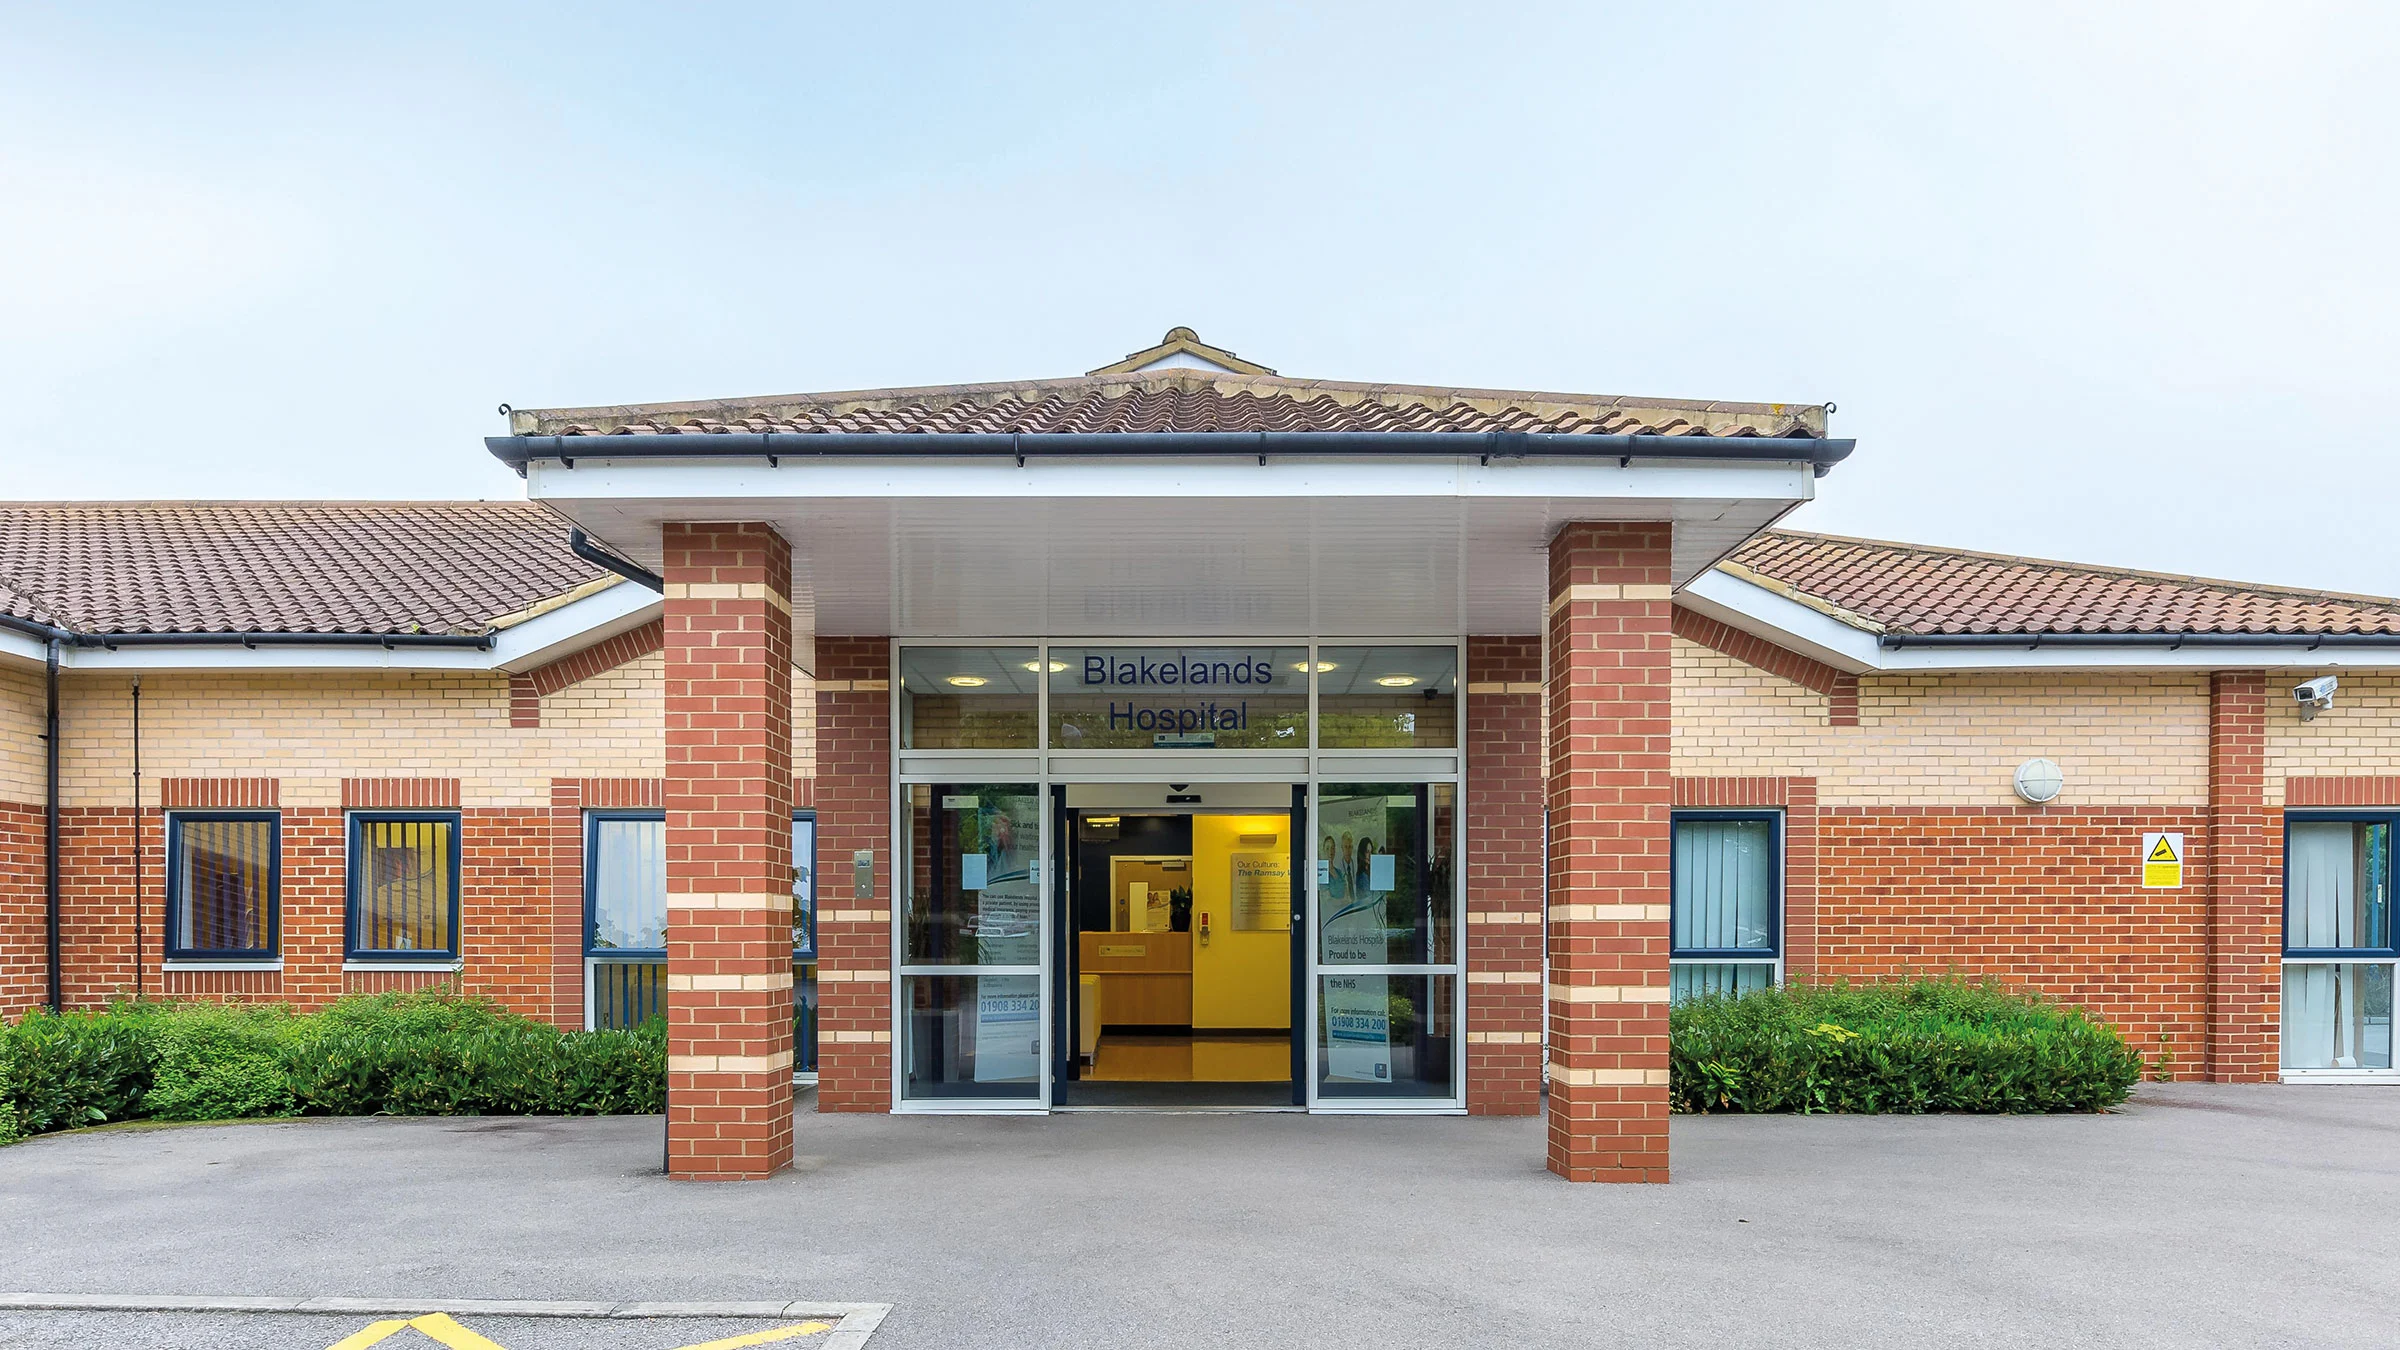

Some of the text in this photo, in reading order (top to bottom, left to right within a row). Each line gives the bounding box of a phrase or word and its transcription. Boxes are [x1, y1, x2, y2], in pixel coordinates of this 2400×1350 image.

[1084, 655, 1272, 685] Blakelands
[1109, 701, 1247, 737] Hospital
[1022, 821, 1034, 830] and
[1237, 860, 1279, 868] Our Culture:
[1237, 869, 1252, 877] The
[1254, 869, 1285, 878] Ramsay
[1328, 934, 1358, 945] Blakelands
[1328, 949, 1366, 959] Proud to be
[1330, 978, 1356, 989] the NHS
[981, 999, 1039, 1012] 01908 334 20
[1330, 1006, 1339, 1014] For
[1350, 1008, 1377, 1016] information
[1331, 1016, 1386, 1030] 01908 334 200
